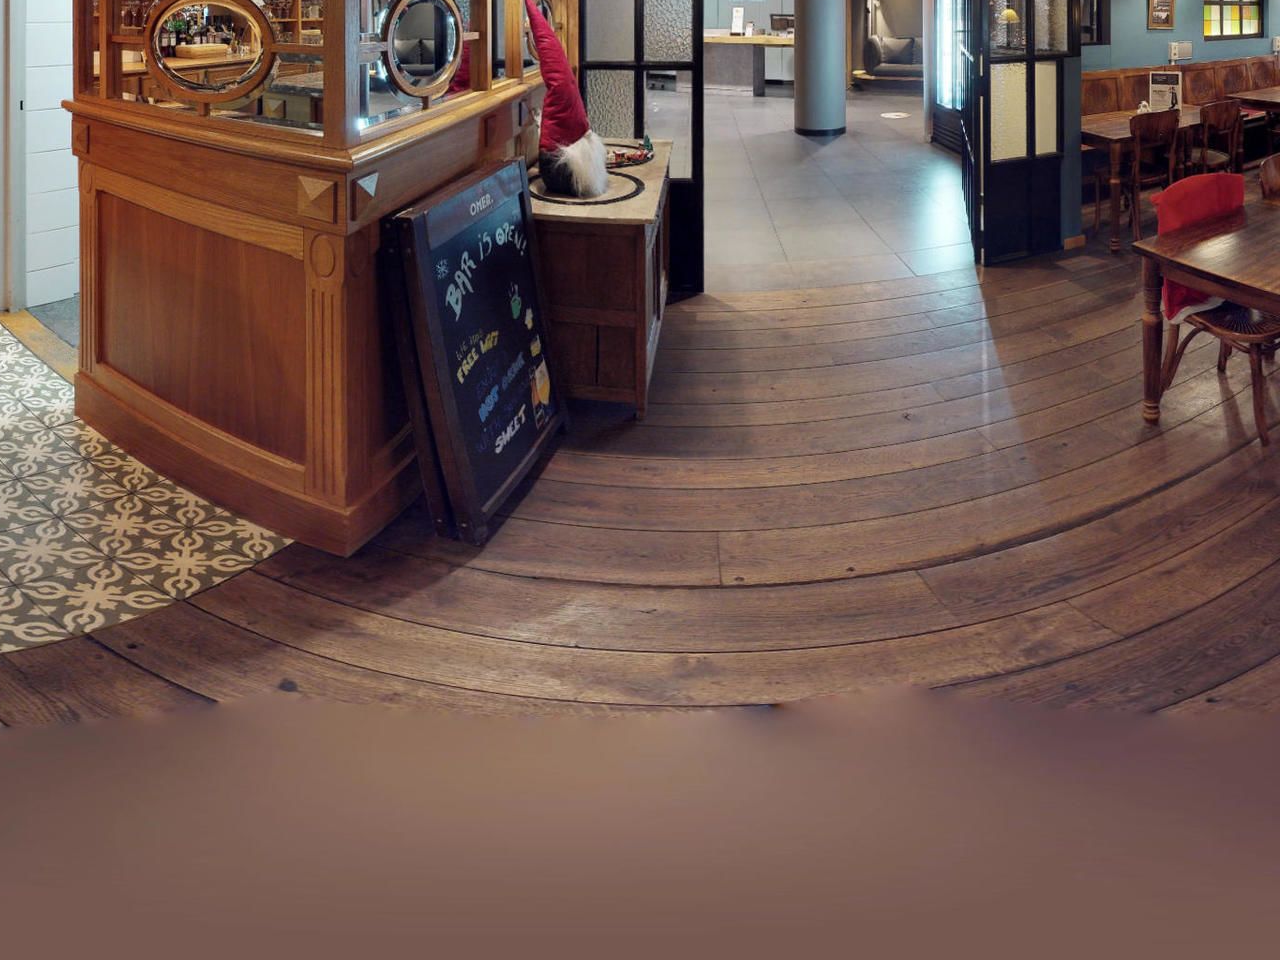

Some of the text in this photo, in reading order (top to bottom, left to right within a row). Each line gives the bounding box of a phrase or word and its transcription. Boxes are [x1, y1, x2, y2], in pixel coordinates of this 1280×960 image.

[445, 250, 477, 322] BAR
[495, 222, 527, 256] OPEN!
[456, 348, 479, 384] FREE
[495, 403, 526, 454] SWEET
